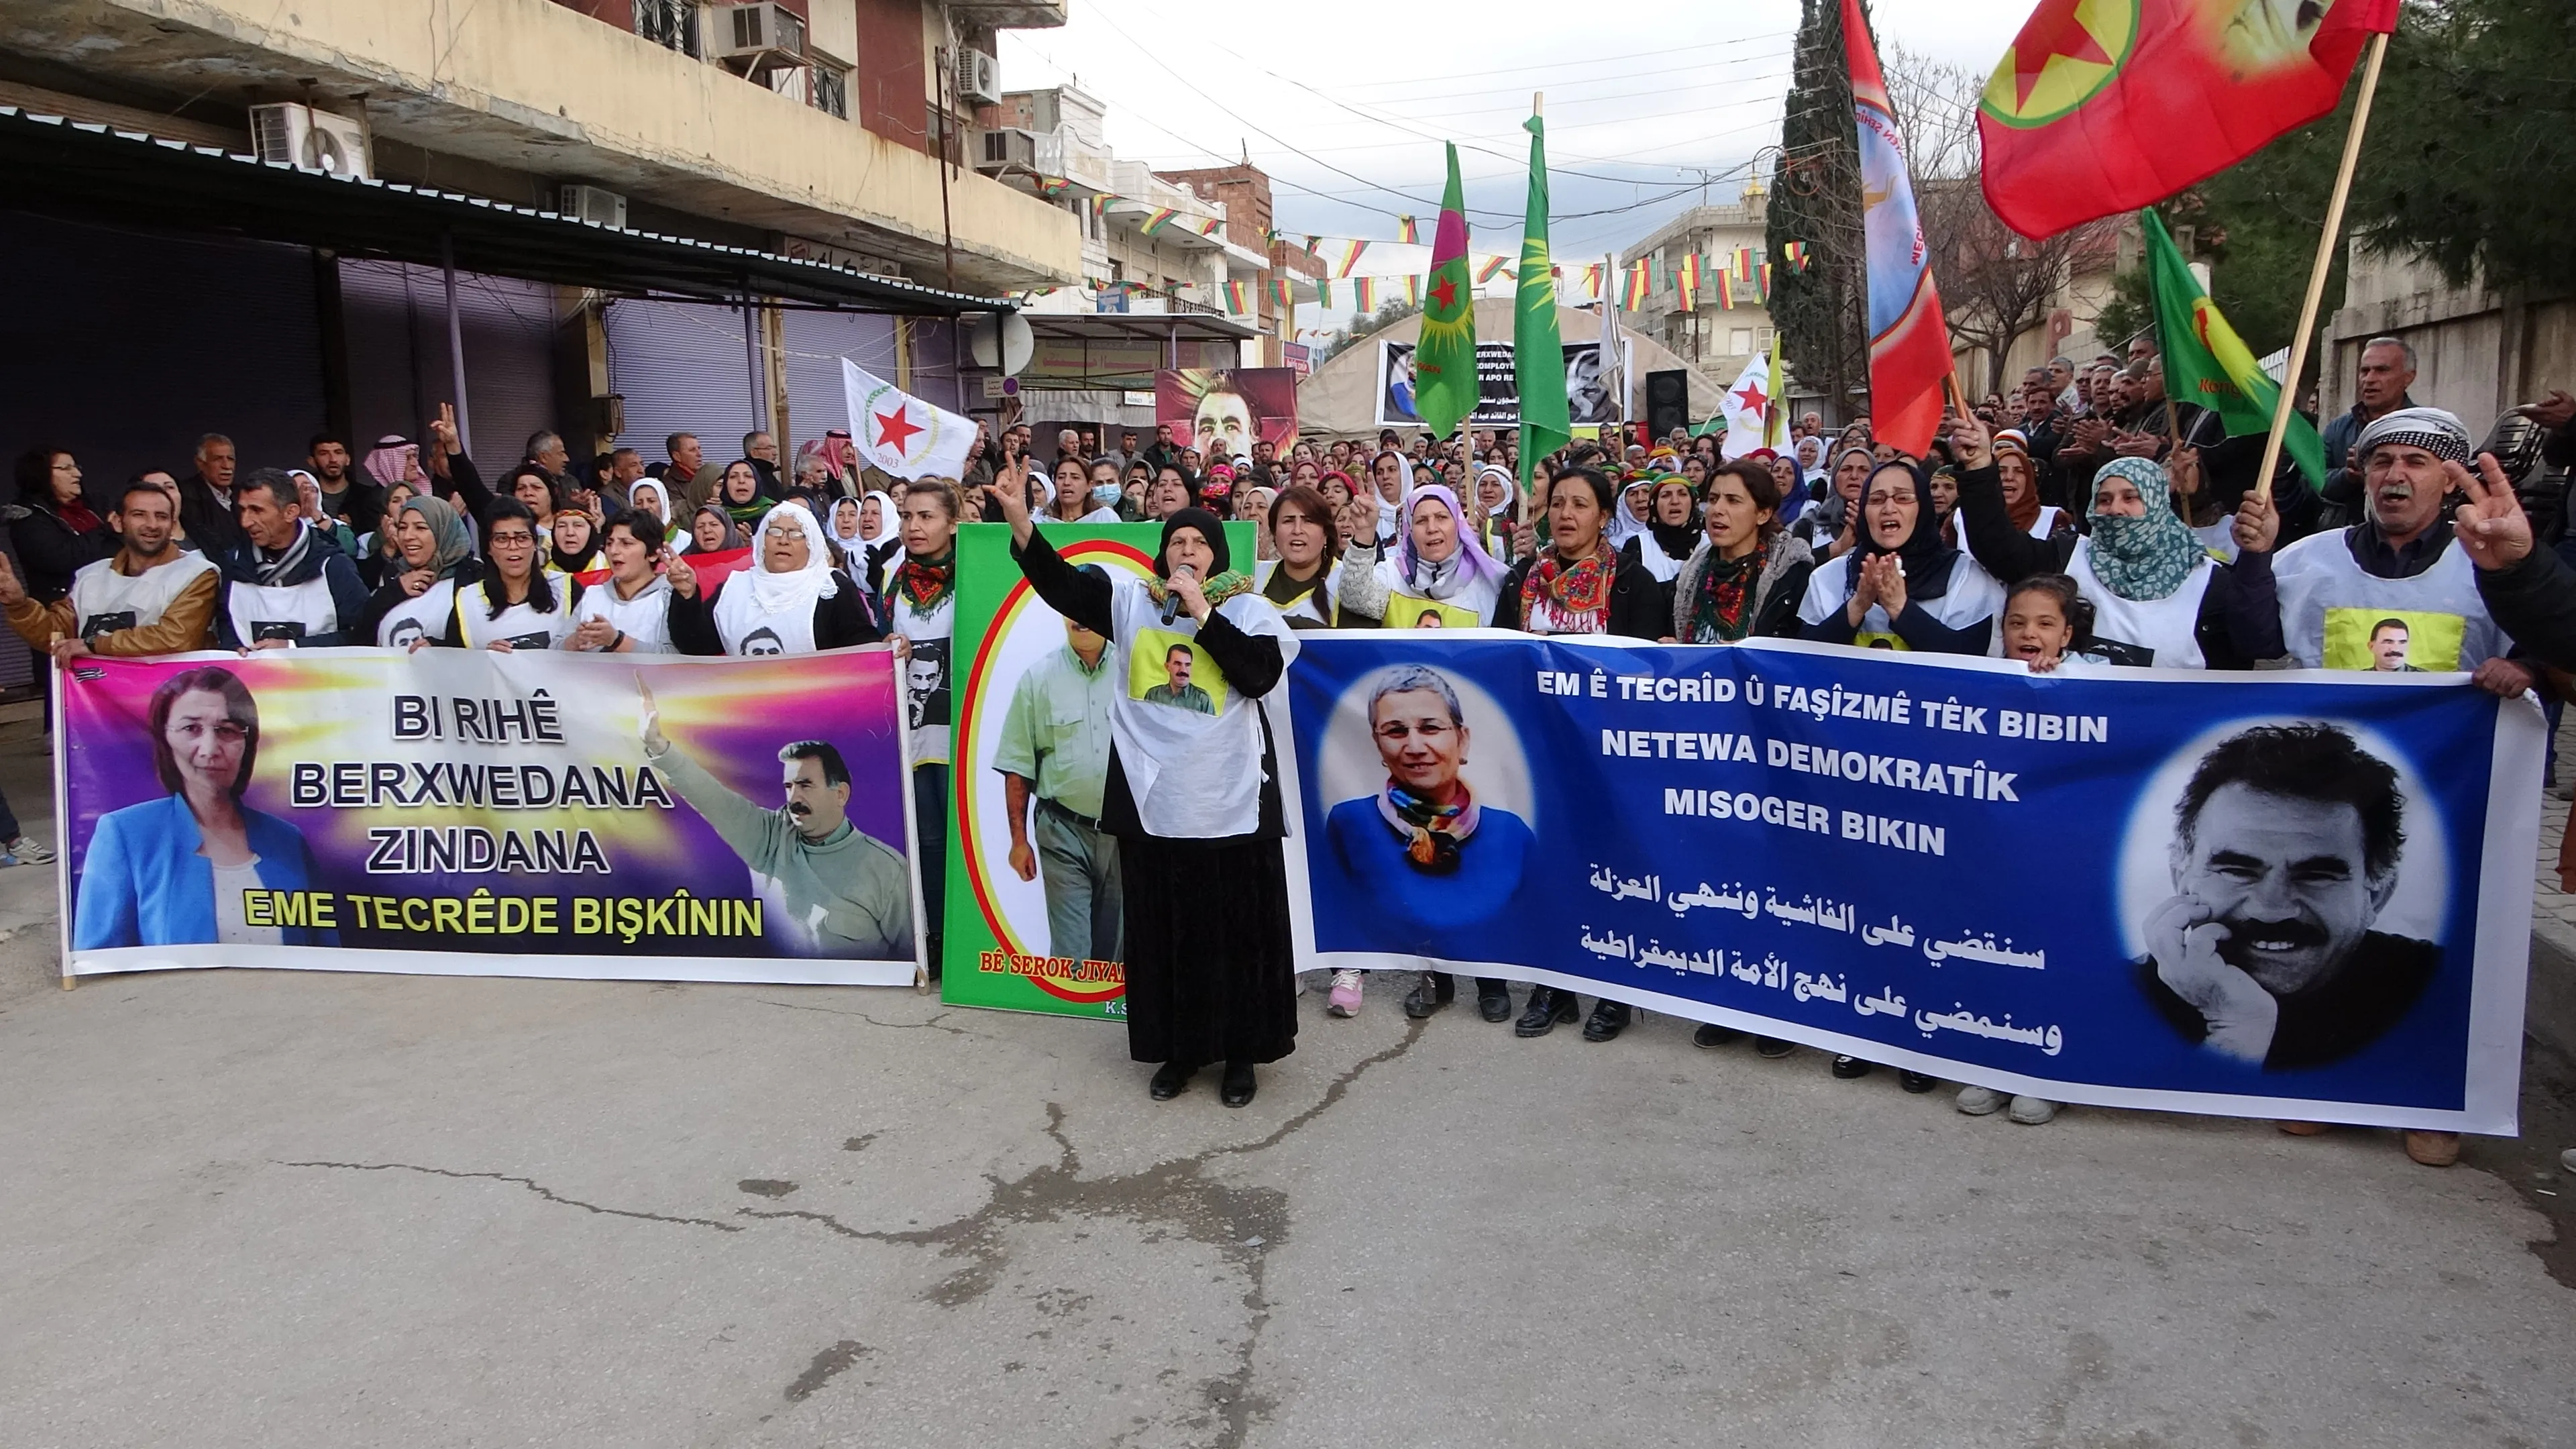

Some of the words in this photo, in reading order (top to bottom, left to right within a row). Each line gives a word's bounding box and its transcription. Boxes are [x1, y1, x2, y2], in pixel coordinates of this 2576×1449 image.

[877, 452, 900, 469] 2003
[393, 694, 444, 740] BI
[452, 688, 566, 743] RIHÊ
[1537, 671, 1580, 696] EM
[1590, 667, 1607, 698] Ê
[1616, 672, 1736, 702] TECRÎD
[1745, 674, 1764, 706] Û
[1774, 683, 1911, 724] FAŞÎZMÊ
[1921, 696, 1988, 735] TÊK
[1998, 710, 2108, 743] BIBIN
[291, 762, 674, 808] BERXWEDANA
[1602, 729, 1758, 763] NETEWA
[1767, 739, 2019, 802] DEMOKRATÎK
[1664, 788, 1830, 835] MISOGER
[1841, 810, 1945, 856] BIKIN
[367, 826, 611, 873] ZINDANA
[1590, 863, 1660, 902] العزلة
[1668, 881, 1759, 920] وننهي
[244, 890, 335, 927] EME
[346, 888, 558, 934] TECRÊDE
[573, 889, 763, 943] BIŞKÎNIN
[1764, 886, 1855, 934] الفاشية
[1862, 915, 1915, 947] على
[979, 947, 1006, 973] BÊ
[1010, 954, 1074, 979] SEROK
[1580, 924, 1724, 977] الديمقراطية
[1730, 951, 1787, 991] الأمة
[1923, 928, 2045, 970] سنقضي
[1793, 971, 1847, 1004] نهج
[1854, 985, 1907, 1018] على
[1915, 1002, 2062, 1057] وسنمضي
